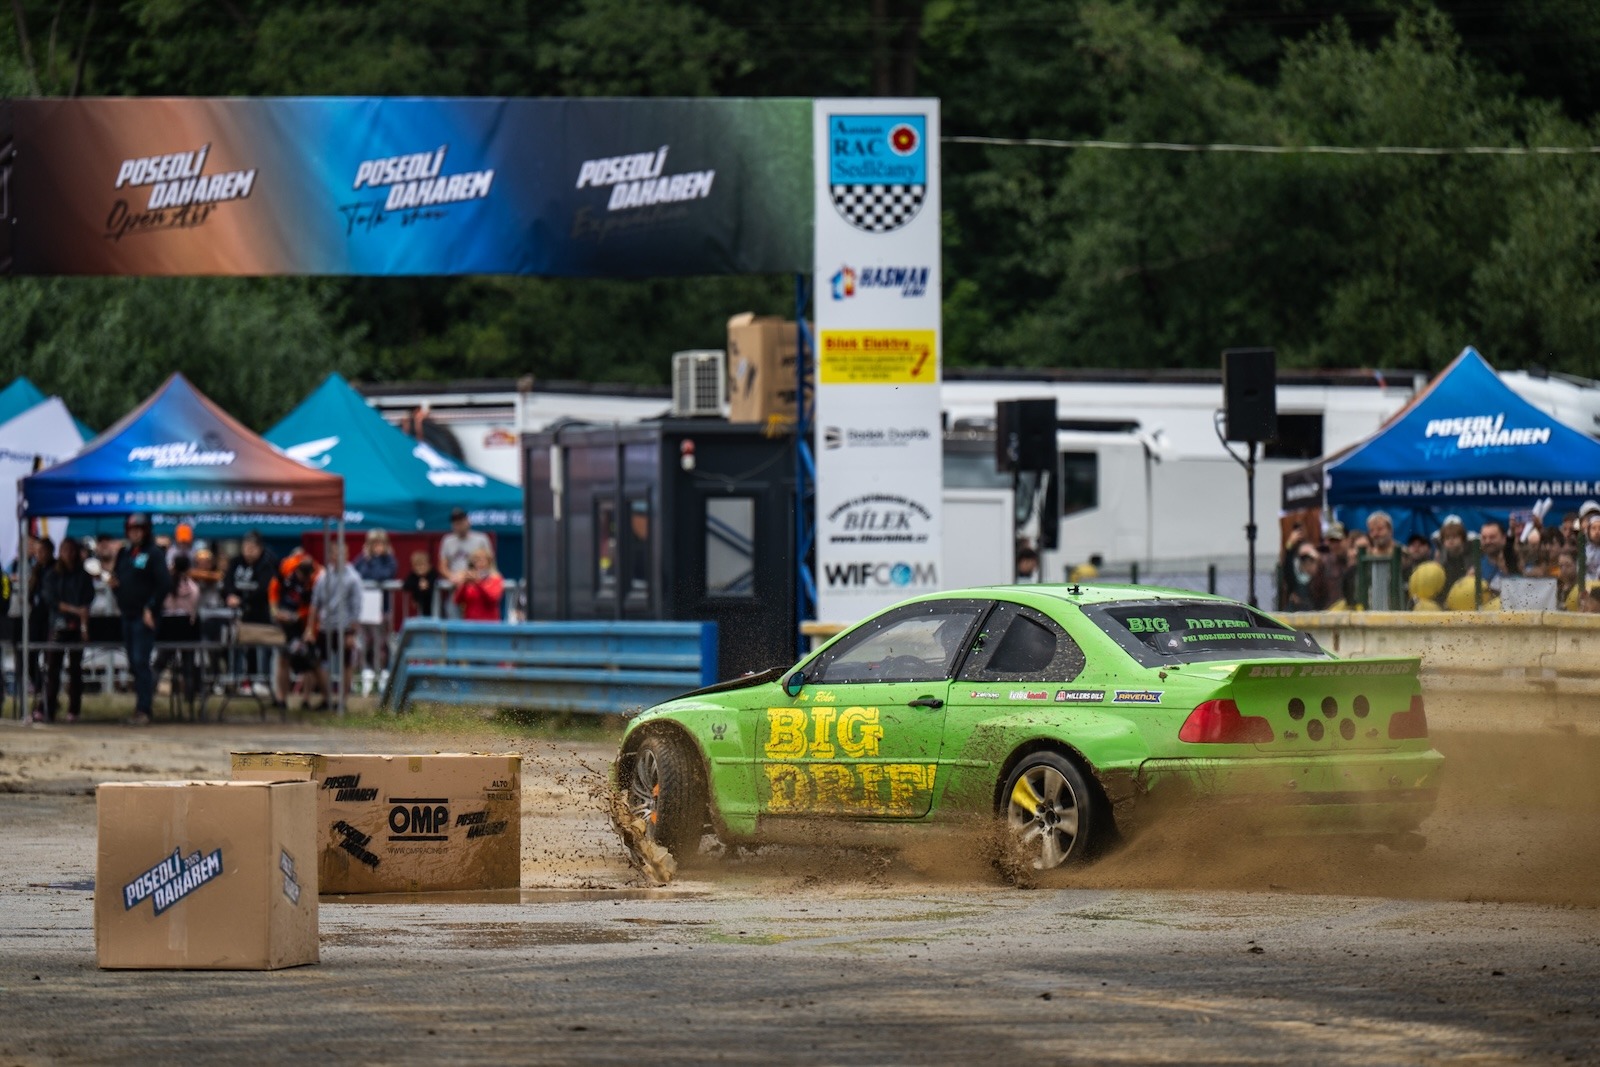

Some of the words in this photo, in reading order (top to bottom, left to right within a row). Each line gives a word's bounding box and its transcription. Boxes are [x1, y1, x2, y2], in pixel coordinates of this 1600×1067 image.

[834, 138, 883, 156] RAC
[146, 169, 256, 211] DAKAREM
[384, 169, 494, 211] DAKAREM
[607, 169, 716, 211] DAKAREM
[825, 561, 937, 586] WIFCOM
[1127, 617, 1170, 632] BIG
[1249, 666, 1295, 677] BMW
[1091, 692, 1104, 700] OILS
[1119, 693, 1157, 701] RAVENOL
[764, 707, 884, 759] BIG
[491, 780, 508, 788] ALTO
[388, 805, 449, 834] OMP
[154, 852, 220, 911] DAKAREM
